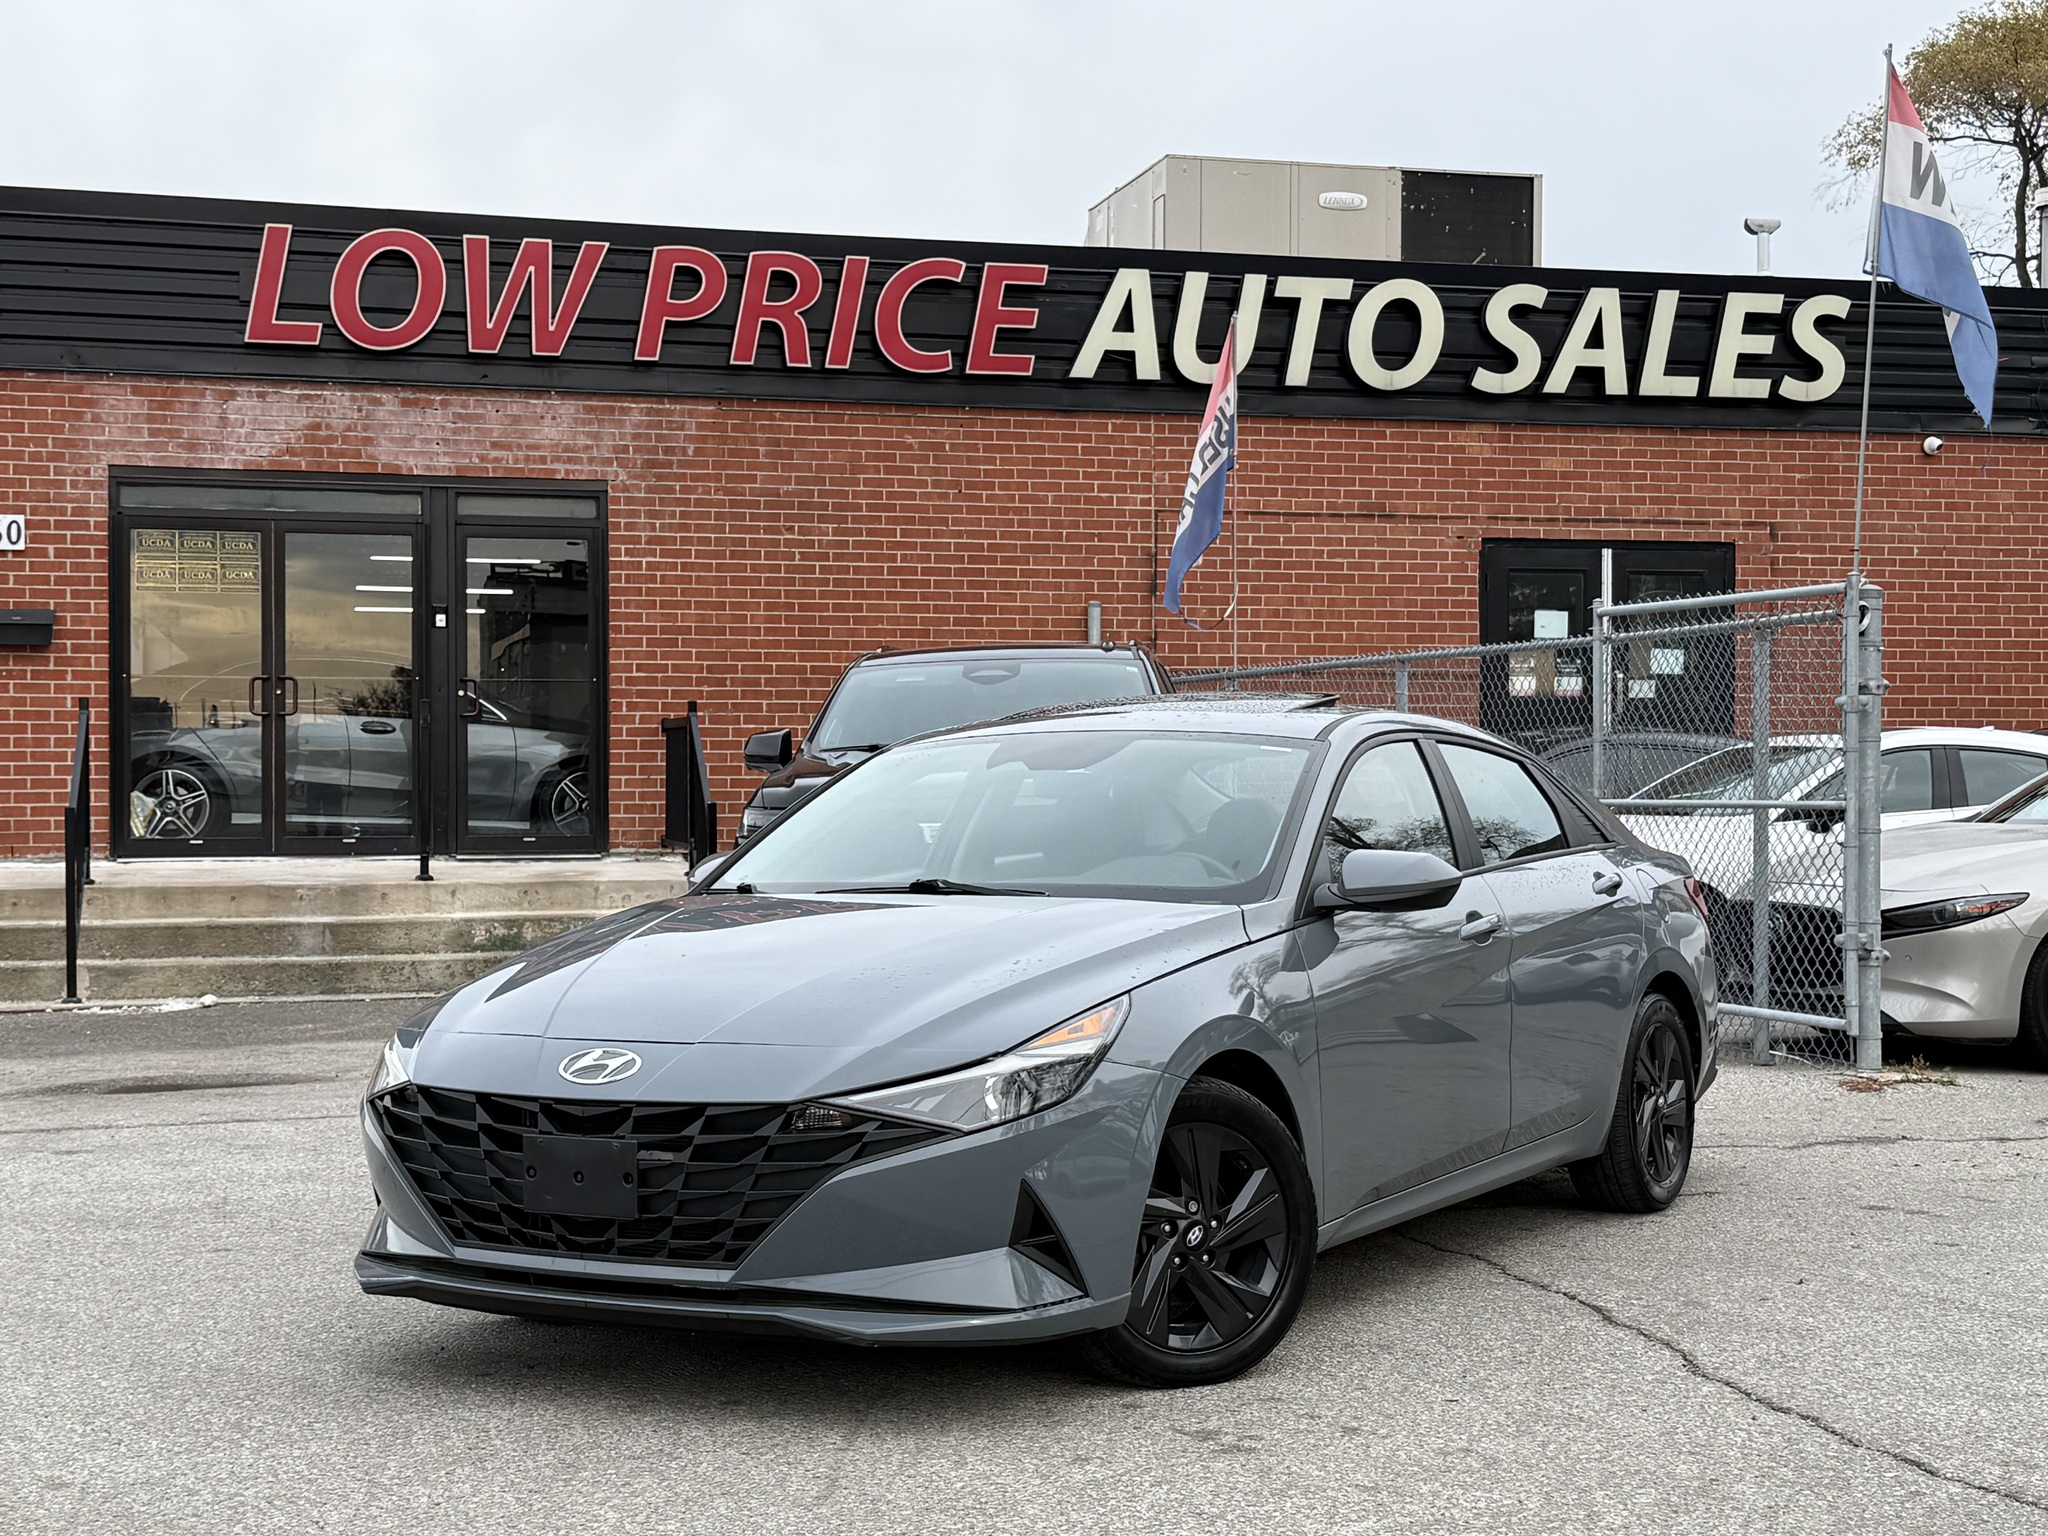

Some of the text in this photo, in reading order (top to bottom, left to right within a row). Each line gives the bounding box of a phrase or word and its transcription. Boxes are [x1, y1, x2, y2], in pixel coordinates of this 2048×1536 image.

[244, 223, 1852, 402] LOW PRICE AUTO SALES
[0, 519, 22, 546] 0
[142, 538, 171, 548] UCDA
[184, 540, 213, 549] UCDA
[225, 541, 254, 550] UCDA
[142, 568, 171, 579] UCDA
[184, 570, 212, 579] UCDA
[226, 571, 255, 579] UCDA
